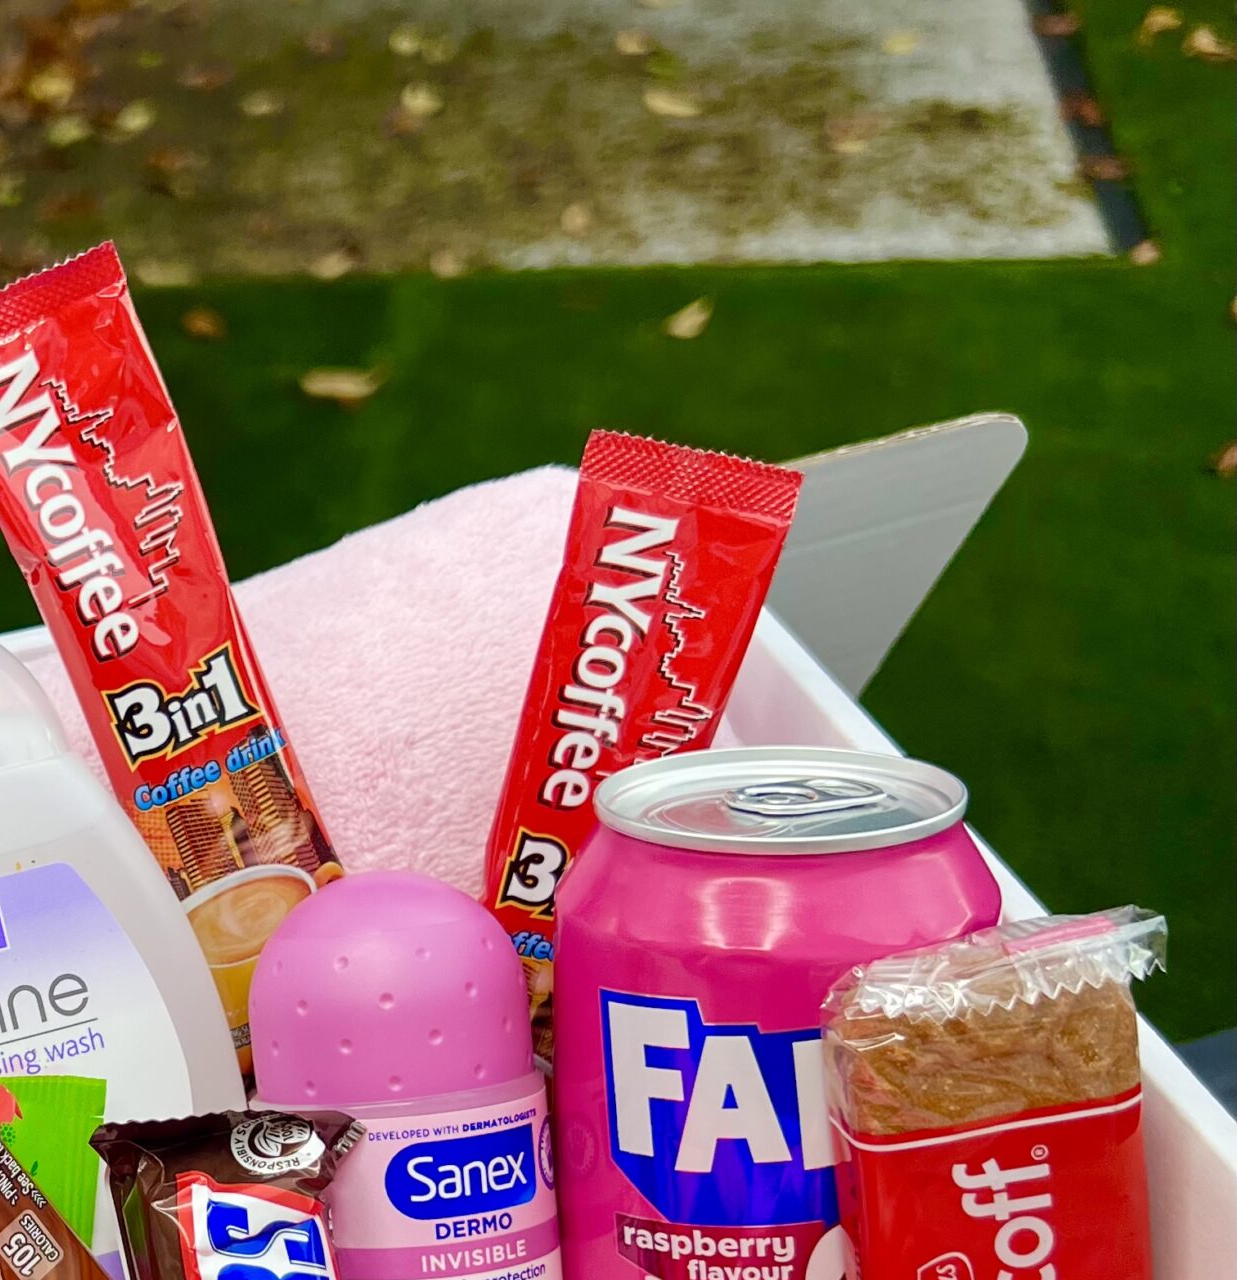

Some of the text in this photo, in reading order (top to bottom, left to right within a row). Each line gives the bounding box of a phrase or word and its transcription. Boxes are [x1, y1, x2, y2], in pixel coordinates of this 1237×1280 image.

[541, 506, 679, 809] NYcoffee
[110, 652, 252, 758] 3in1
[135, 729, 285, 811] Coffee drink
[44, 1027, 105, 1063] wash
[368, 1108, 537, 1142] DEVELOPED WITH DERMATOLOGISTS
[406, 1151, 528, 1203] Sanex
[18, 1214, 60, 1262] CALORIES
[435, 1212, 513, 1241] DERMO
[623, 1224, 795, 1262] raspberry
[0, 1230, 45, 1278] 105
[420, 1239, 527, 1273] INVISIBLE
